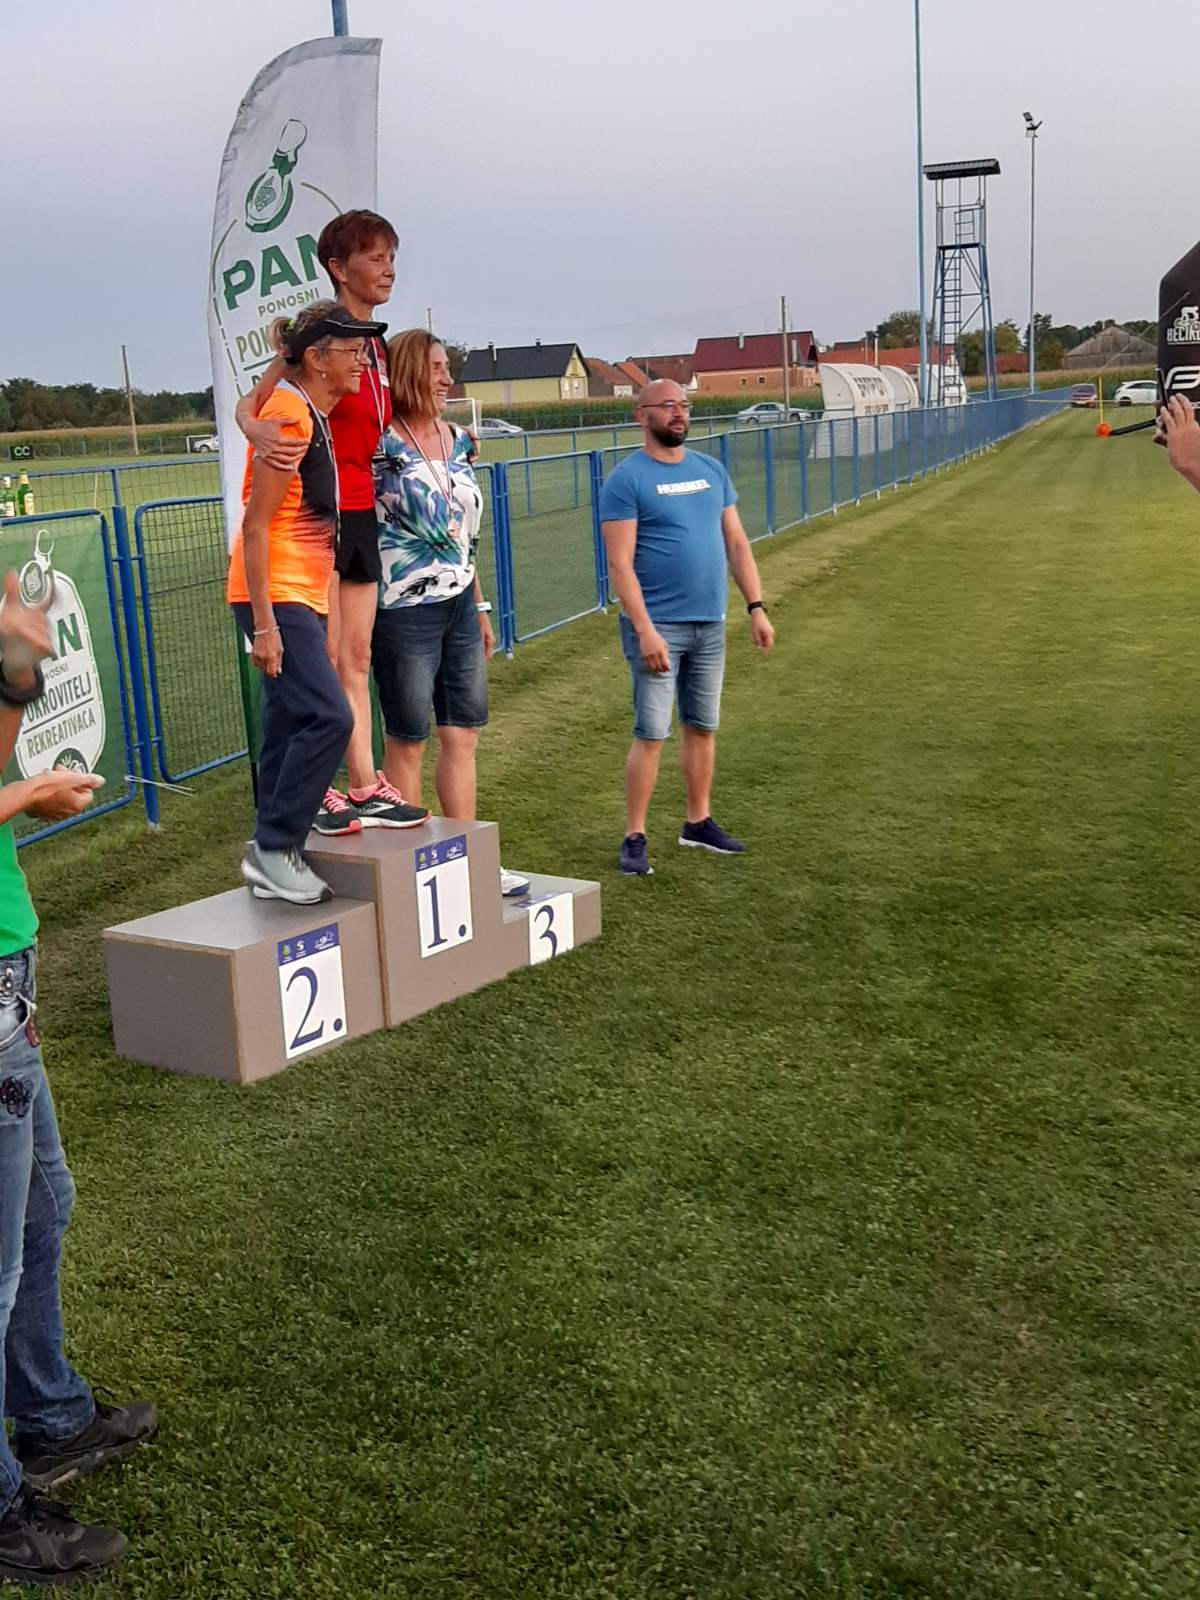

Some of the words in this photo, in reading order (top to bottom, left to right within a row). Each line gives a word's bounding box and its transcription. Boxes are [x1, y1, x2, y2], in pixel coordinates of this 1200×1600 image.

[257, 288, 320, 317] PONOSNI
[25, 671, 92, 723] OKROVITELJ
[27, 708, 96, 758] REKREATIVACA
[423, 874, 467, 949] 1.
[286, 966, 343, 1050] 2.
